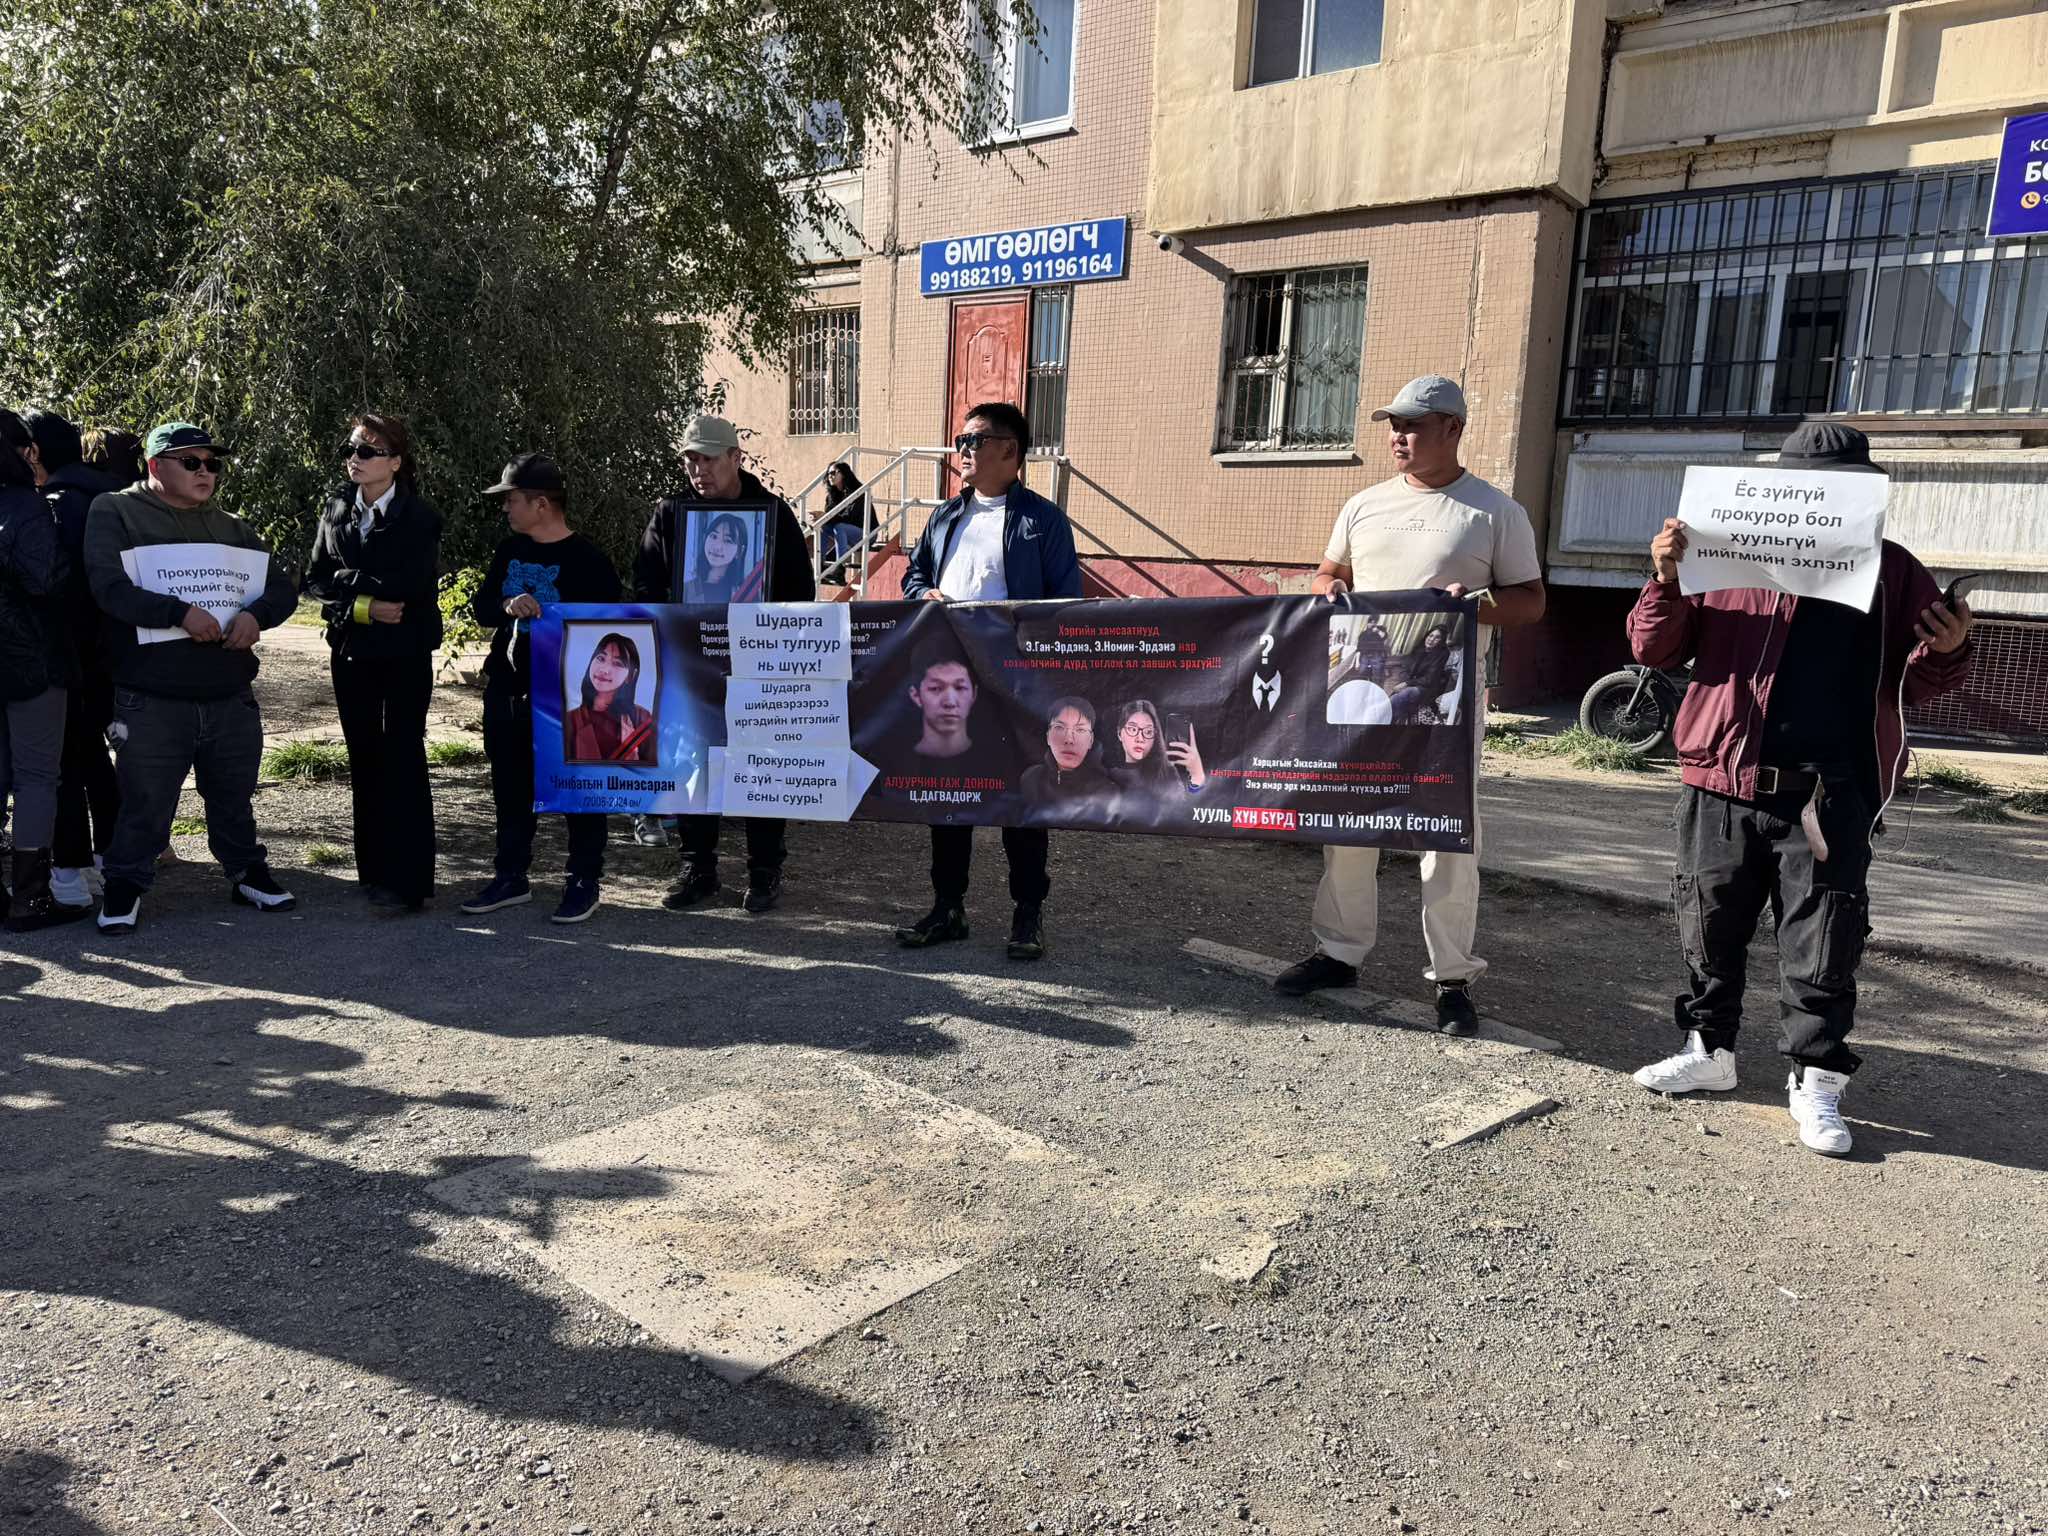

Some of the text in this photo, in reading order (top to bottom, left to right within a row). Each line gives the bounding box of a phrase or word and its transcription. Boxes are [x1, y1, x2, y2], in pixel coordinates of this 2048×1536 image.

[945, 224, 1099, 265] ӨМГӨӨЛӨГЧ
[930, 253, 1112, 290] 99188219, 91196164
[1735, 480, 1825, 504] Ёс зүйгүй
[1711, 508, 1842, 527] прокурор бол
[1731, 533, 1816, 550] хуульгүй
[1791, 558, 1855, 572] эхлэл!
[168, 582, 222, 595] хүндийг
[756, 614, 823, 628] Шударга
[701, 635, 729, 645] Прокуро
[739, 636, 841, 653] ёсны тулгуур
[702, 647, 730, 657] Прокуро
[758, 659, 822, 675] нь шүүх!
[761, 683, 811, 695] Шударга
[744, 699, 829, 710] шийдвэрээрээ
[735, 714, 840, 727] иргэдийн итгэлийг
[774, 732, 803, 741] олно
[747, 754, 825, 769] Прокурорын
[607, 775, 675, 793] Шинэсаран
[734, 773, 748, 784] ёс
[751, 773, 772, 786] зүй
[785, 777, 837, 788] шударга
[885, 776, 937, 789] АЛУУРЧИН
[940, 777, 961, 789] ГАЖ
[747, 791, 823, 805] ёсны суурь!
[909, 790, 982, 803] Ц.ДАГВАДОРЖ
[1192, 807, 1463, 833] ХУУЛЬ ХҮН БҮРД ТЭГШ ҮЙЛЧЛЭХ ЁСТОЙ!!!
